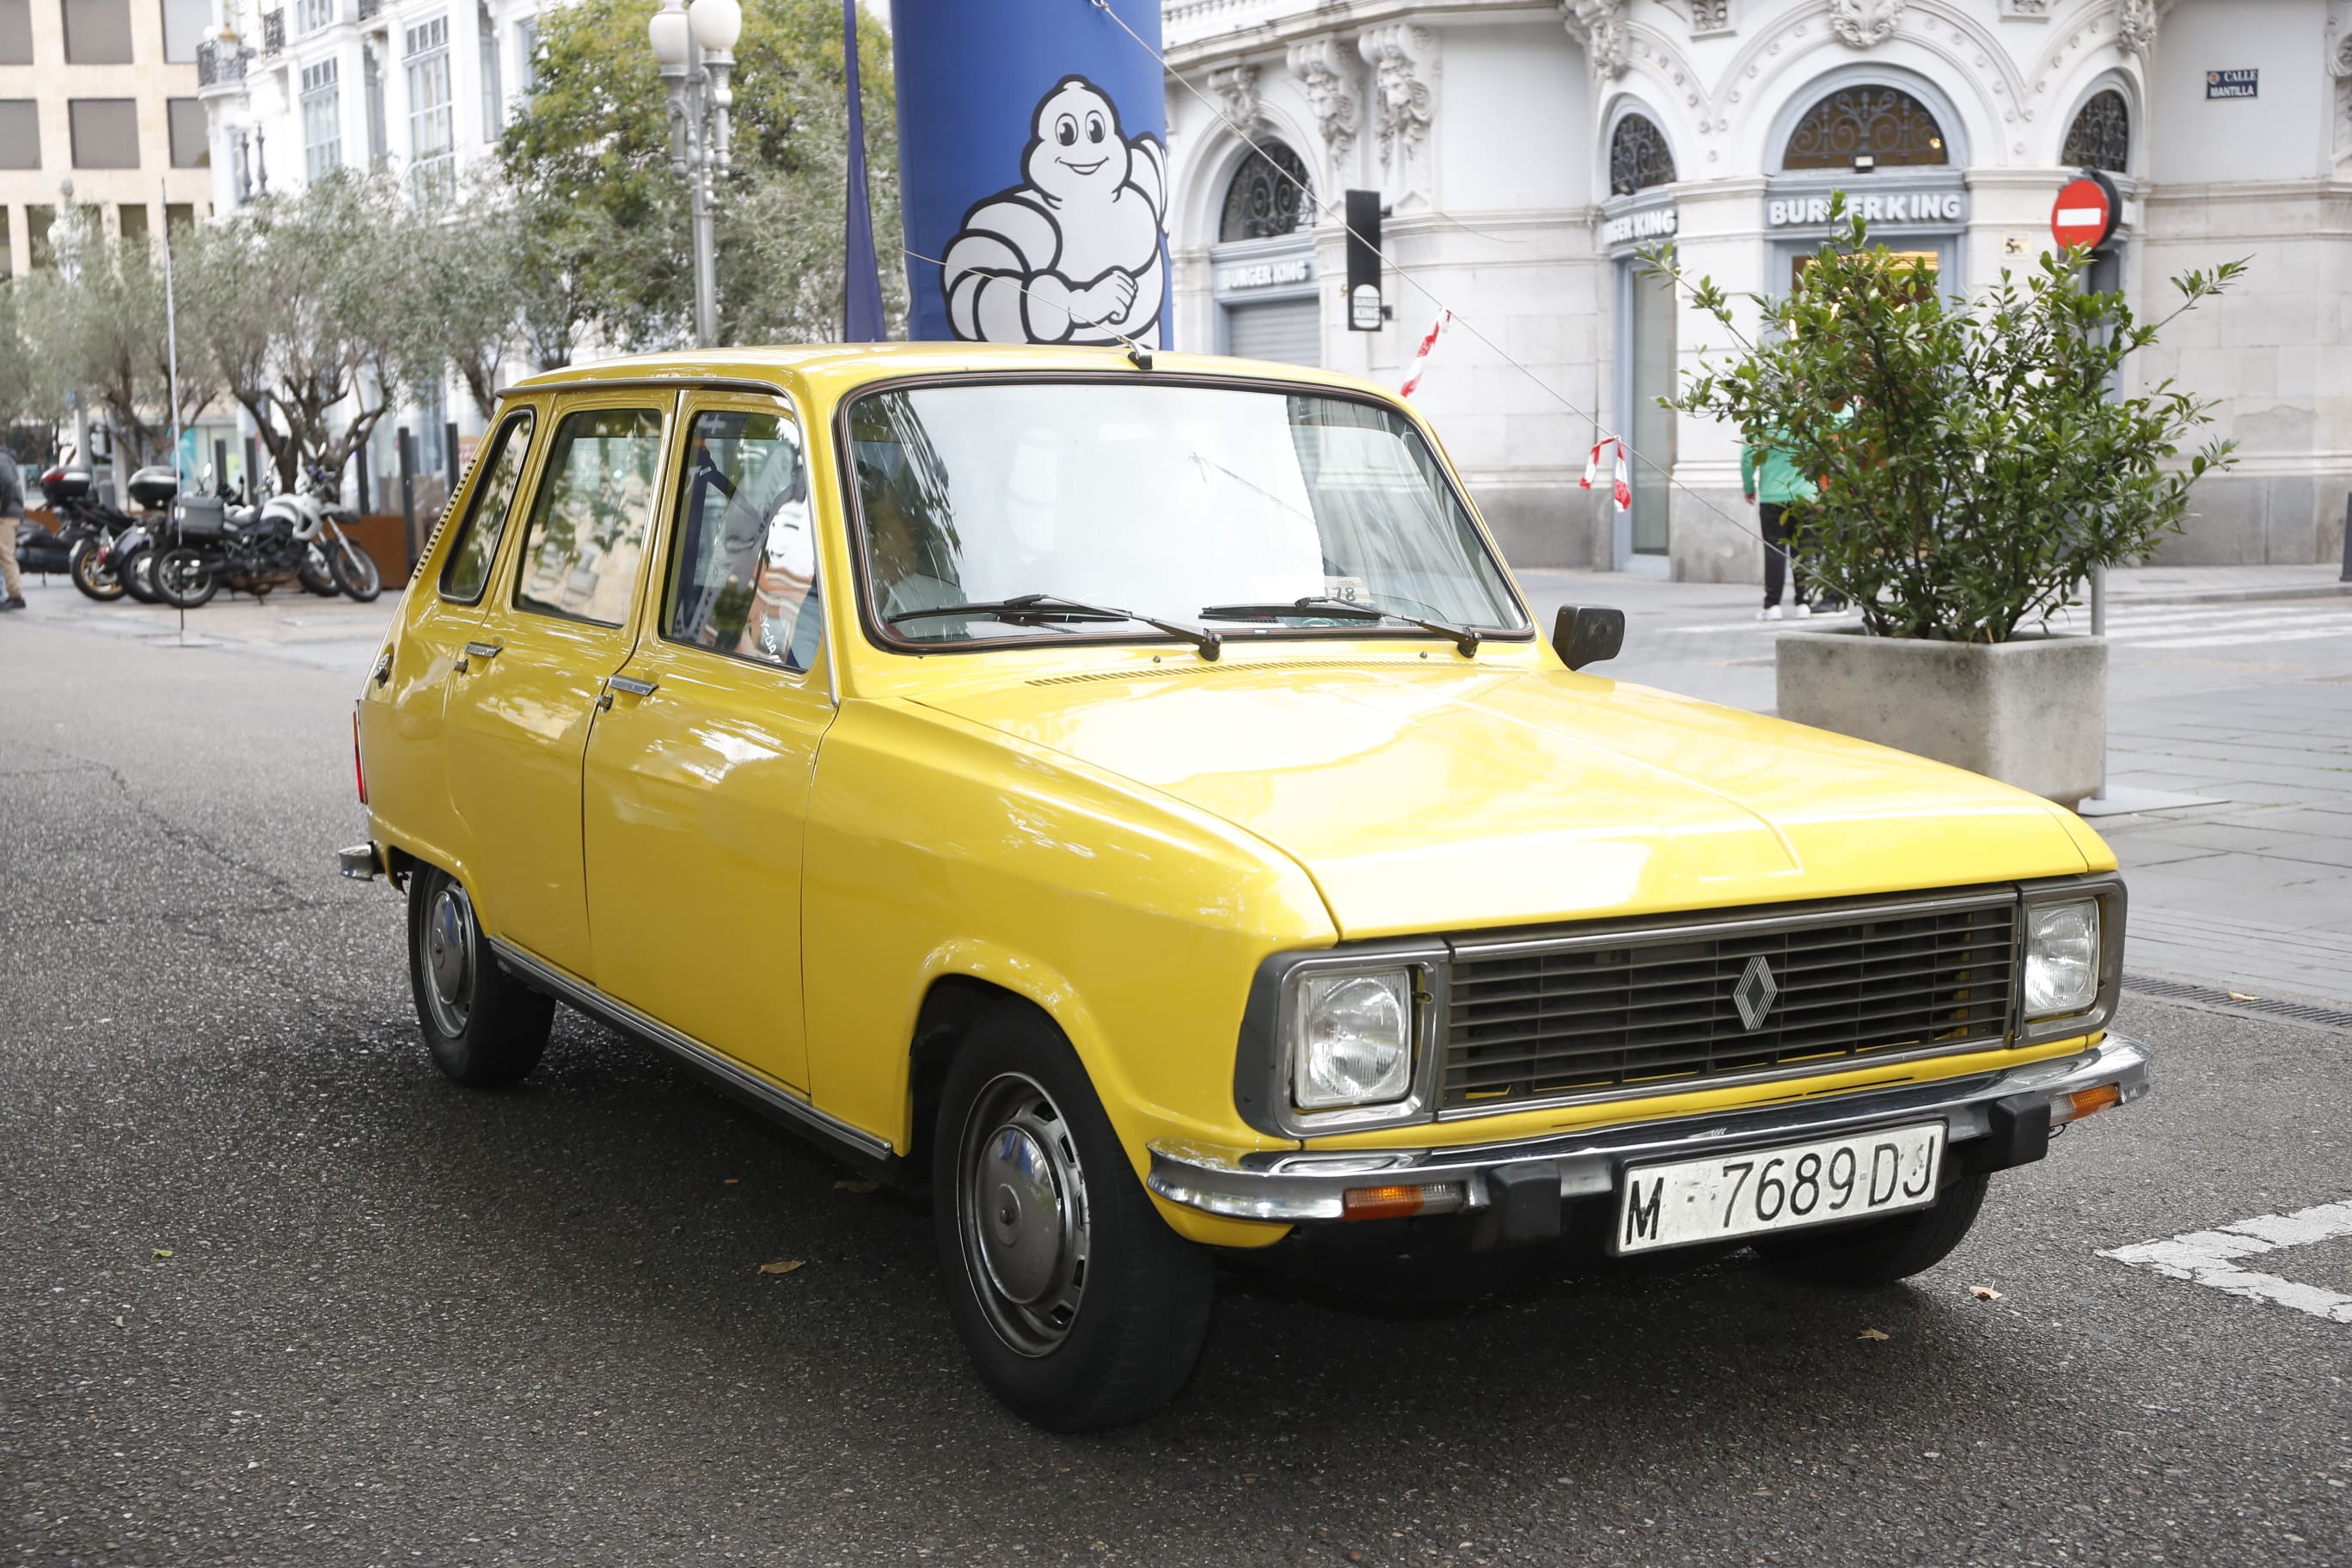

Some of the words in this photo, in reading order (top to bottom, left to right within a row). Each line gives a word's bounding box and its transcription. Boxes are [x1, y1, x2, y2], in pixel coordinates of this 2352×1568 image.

[2224, 70, 2257, 82] CALLE
[2209, 84, 2255, 97] MANTILLA
[1886, 194, 1961, 219] KING
[1633, 209, 1675, 236] KING
[1625, 1177, 1664, 1245] M
[1722, 1147, 1857, 1228] 7689
[1868, 1136, 1935, 1207] DJ
